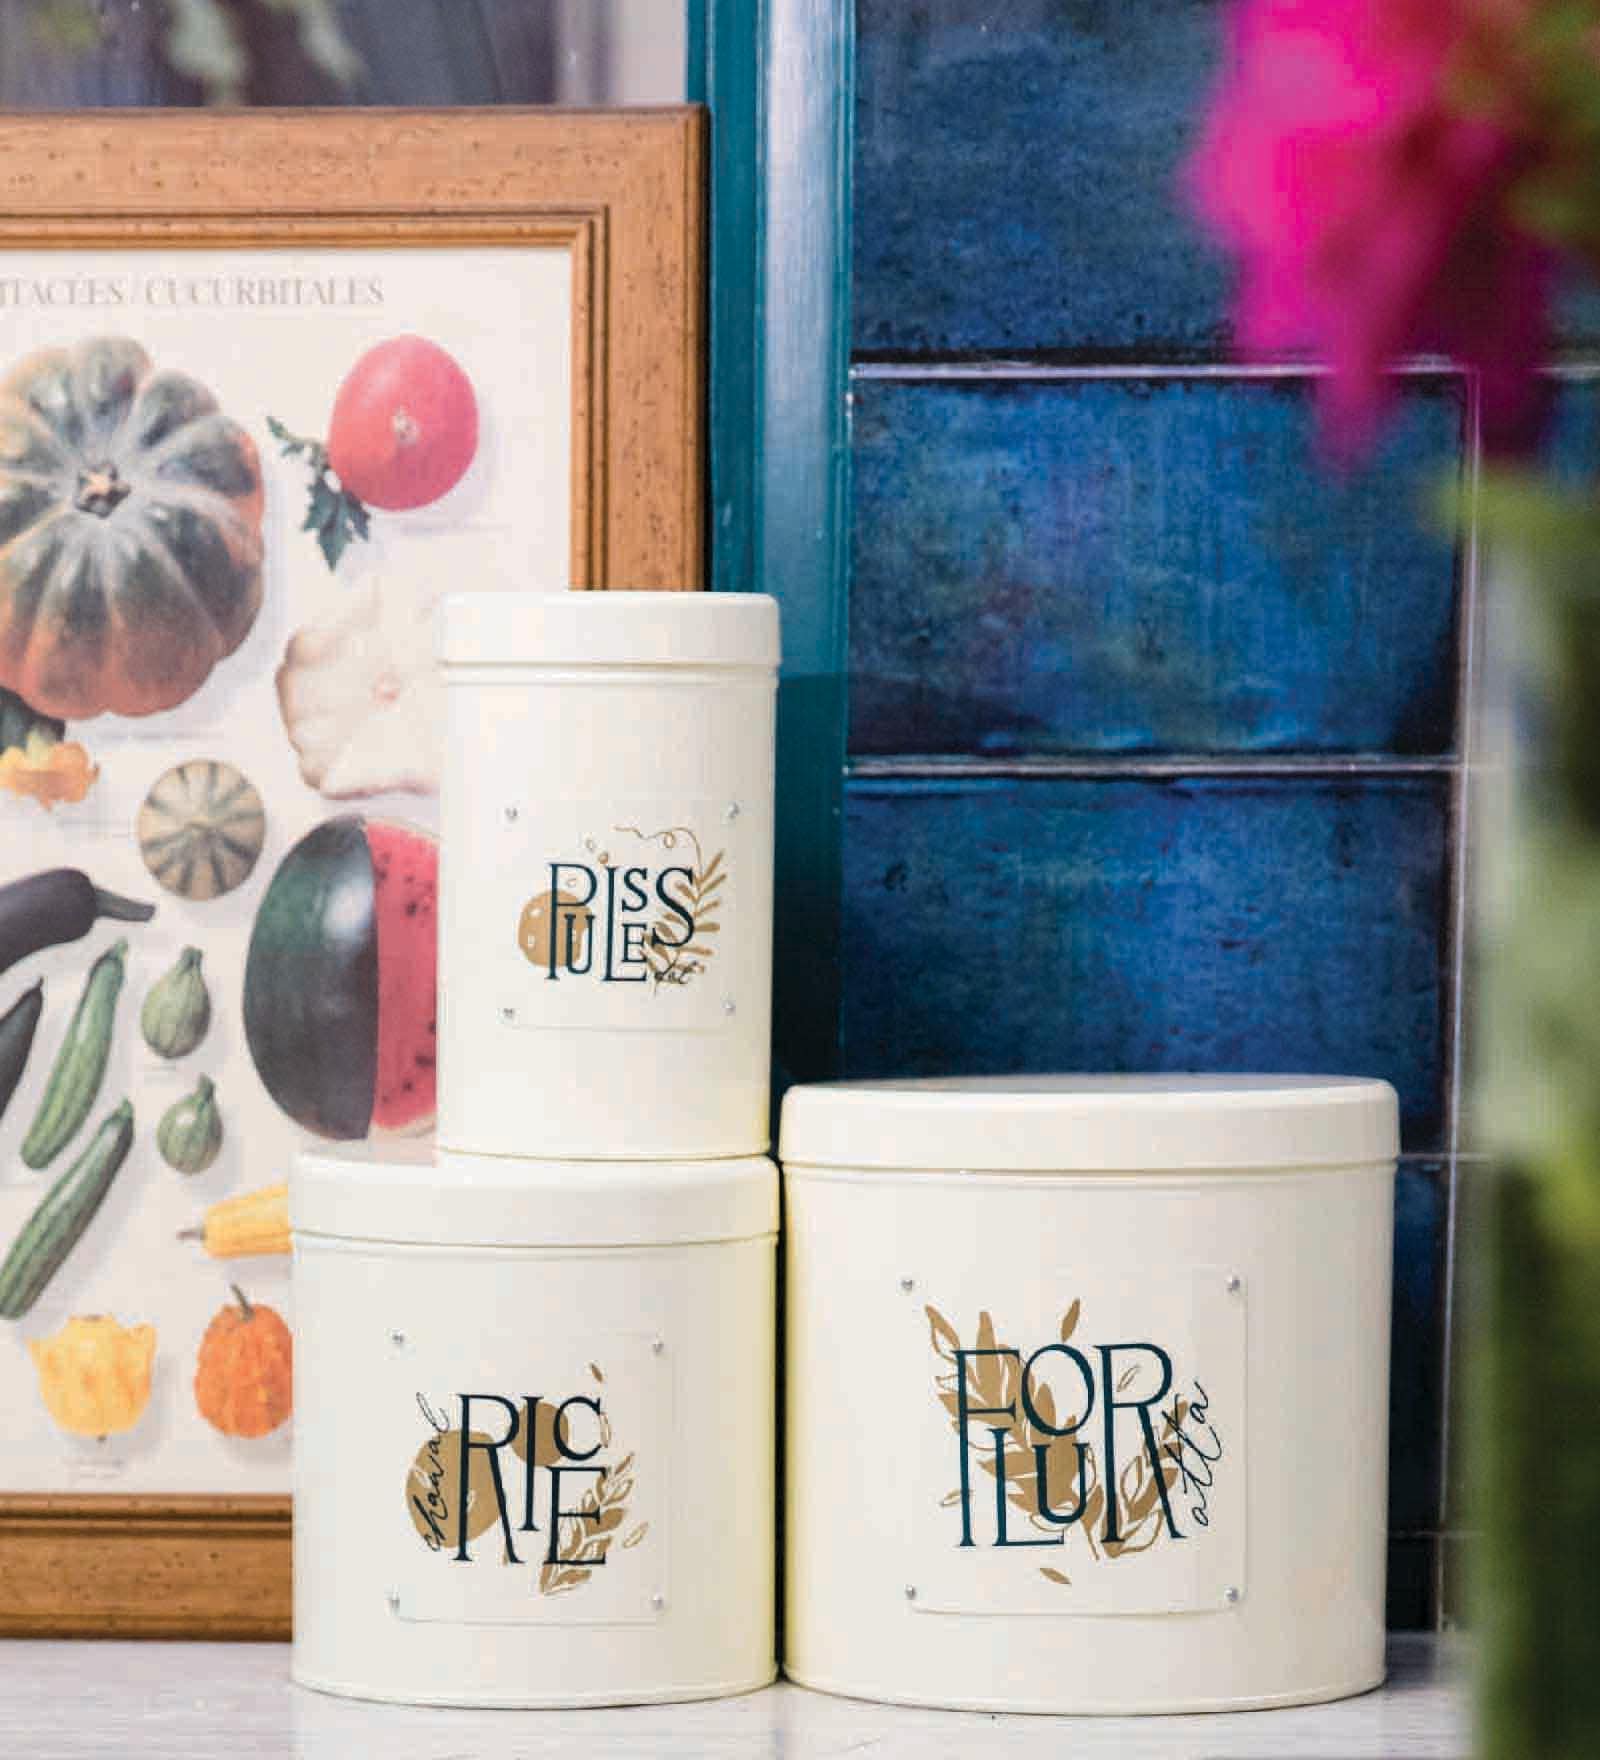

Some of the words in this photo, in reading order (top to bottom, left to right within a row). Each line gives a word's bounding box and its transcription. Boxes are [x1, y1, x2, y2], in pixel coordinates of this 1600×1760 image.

[145, 277, 385, 305] CUCURBITALES
[413, 1391, 450, 1552] chawal
[452, 1393, 607, 1566] RICE
[949, 1342, 1188, 1548] FLOUR
[1161, 1380, 1223, 1527] atta
